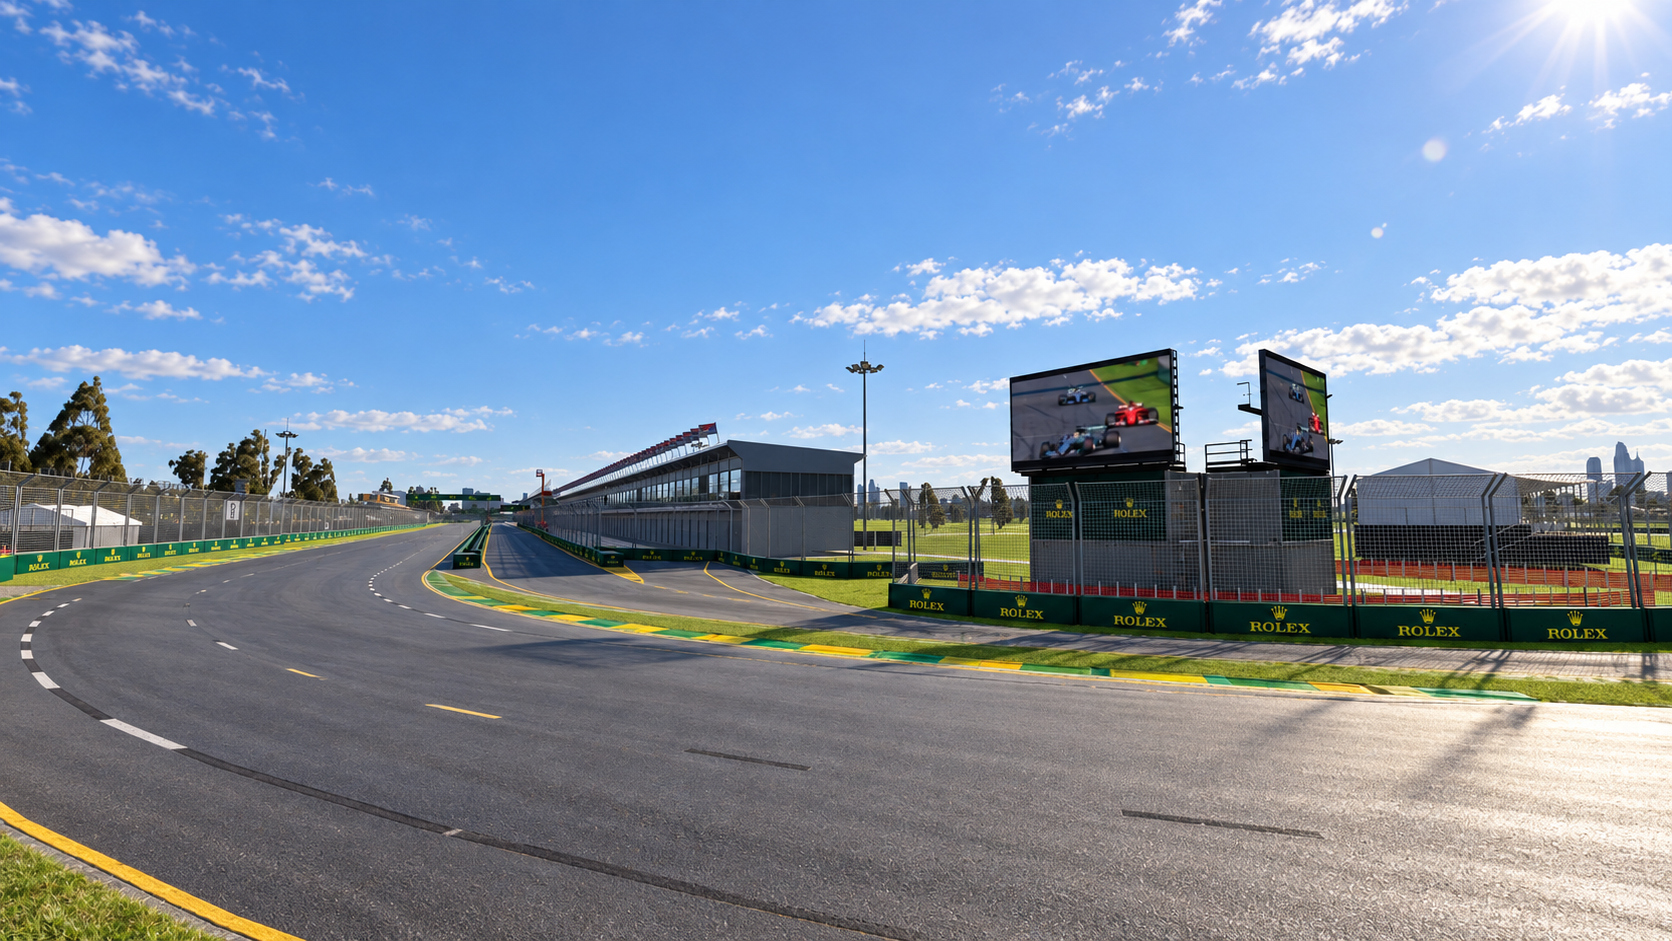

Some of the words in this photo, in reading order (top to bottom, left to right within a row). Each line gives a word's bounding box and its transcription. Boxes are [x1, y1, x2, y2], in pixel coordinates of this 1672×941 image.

[1114, 508, 1147, 519] ROLEX
[909, 599, 944, 612] ROLEX
[1000, 607, 1043, 620] ROLEX
[1114, 615, 1167, 628] ROLEX
[1250, 621, 1311, 634] ROLEX
[1397, 625, 1461, 638] ROLEX
[1547, 628, 1608, 640] ROLEX
